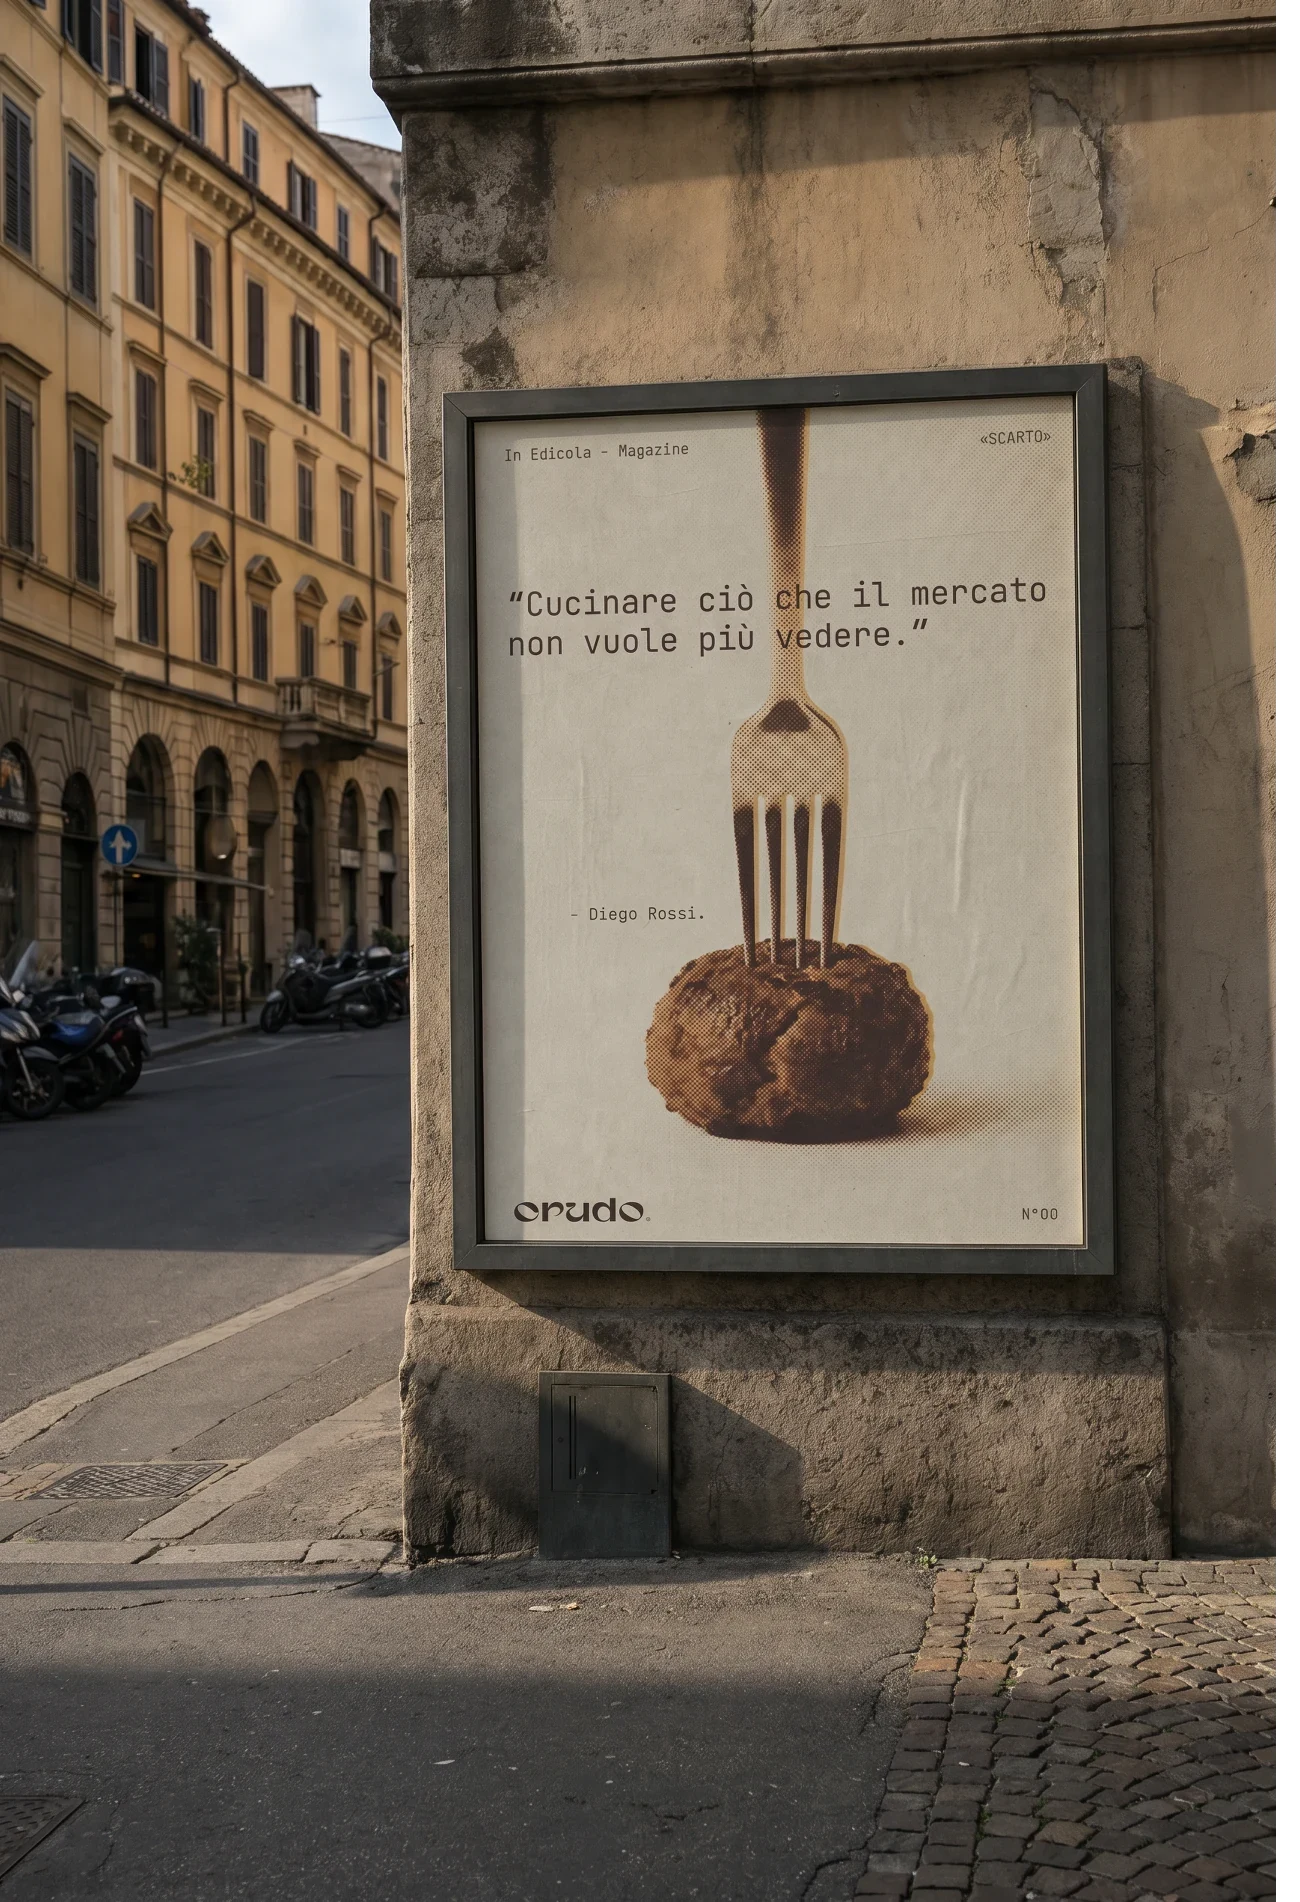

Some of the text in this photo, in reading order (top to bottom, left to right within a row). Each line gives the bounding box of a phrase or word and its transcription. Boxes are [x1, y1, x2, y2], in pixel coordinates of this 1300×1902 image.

[980, 429, 1051, 445] «SCARTO»
[504, 448, 521, 462] In
[531, 446, 591, 461] Edicola
[618, 442, 689, 460] Magazine
[509, 577, 1046, 617] “Cucinare ciò che il mercato
[509, 618, 928, 658] non vuole più vedere.”
[589, 906, 638, 924] Diego
[648, 906, 704, 921] Rossi.
